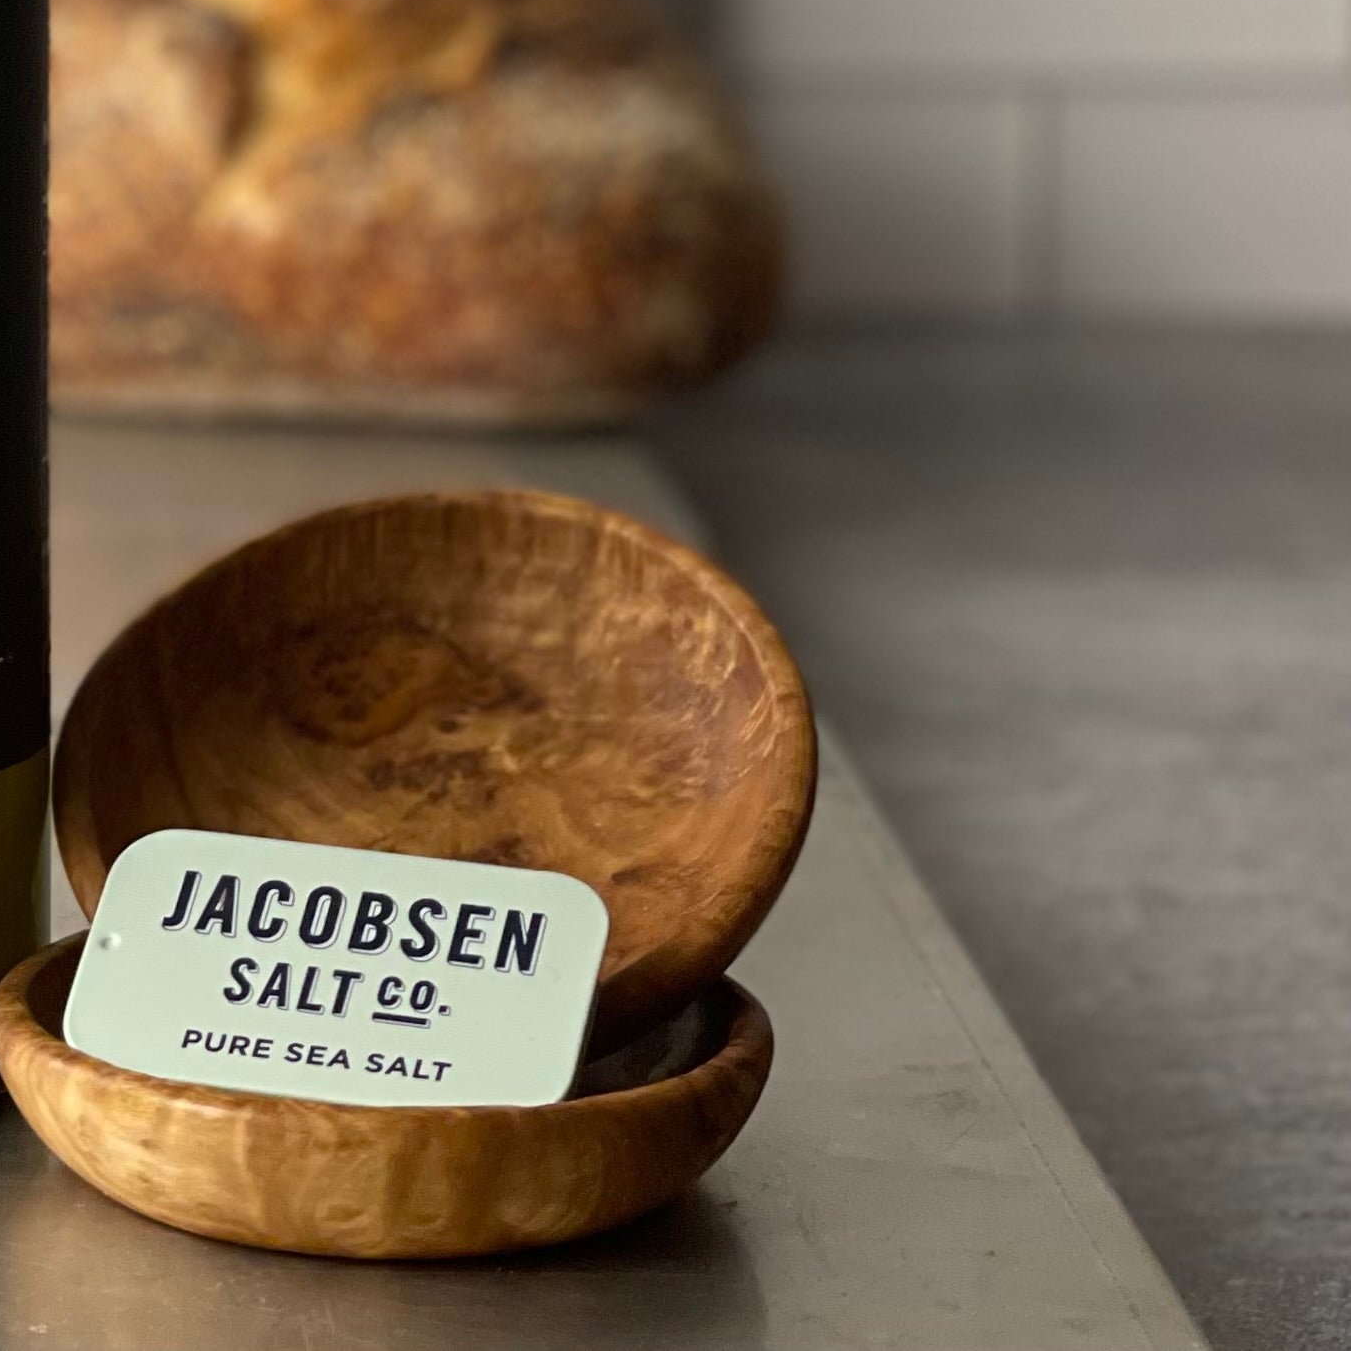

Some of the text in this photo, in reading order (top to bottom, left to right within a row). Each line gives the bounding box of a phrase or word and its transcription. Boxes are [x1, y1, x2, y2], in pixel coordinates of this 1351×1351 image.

[162, 870, 547, 976] JACOBSEN
[223, 957, 364, 1017] SALT
[181, 1029, 453, 1082] PURE SEA SALT
